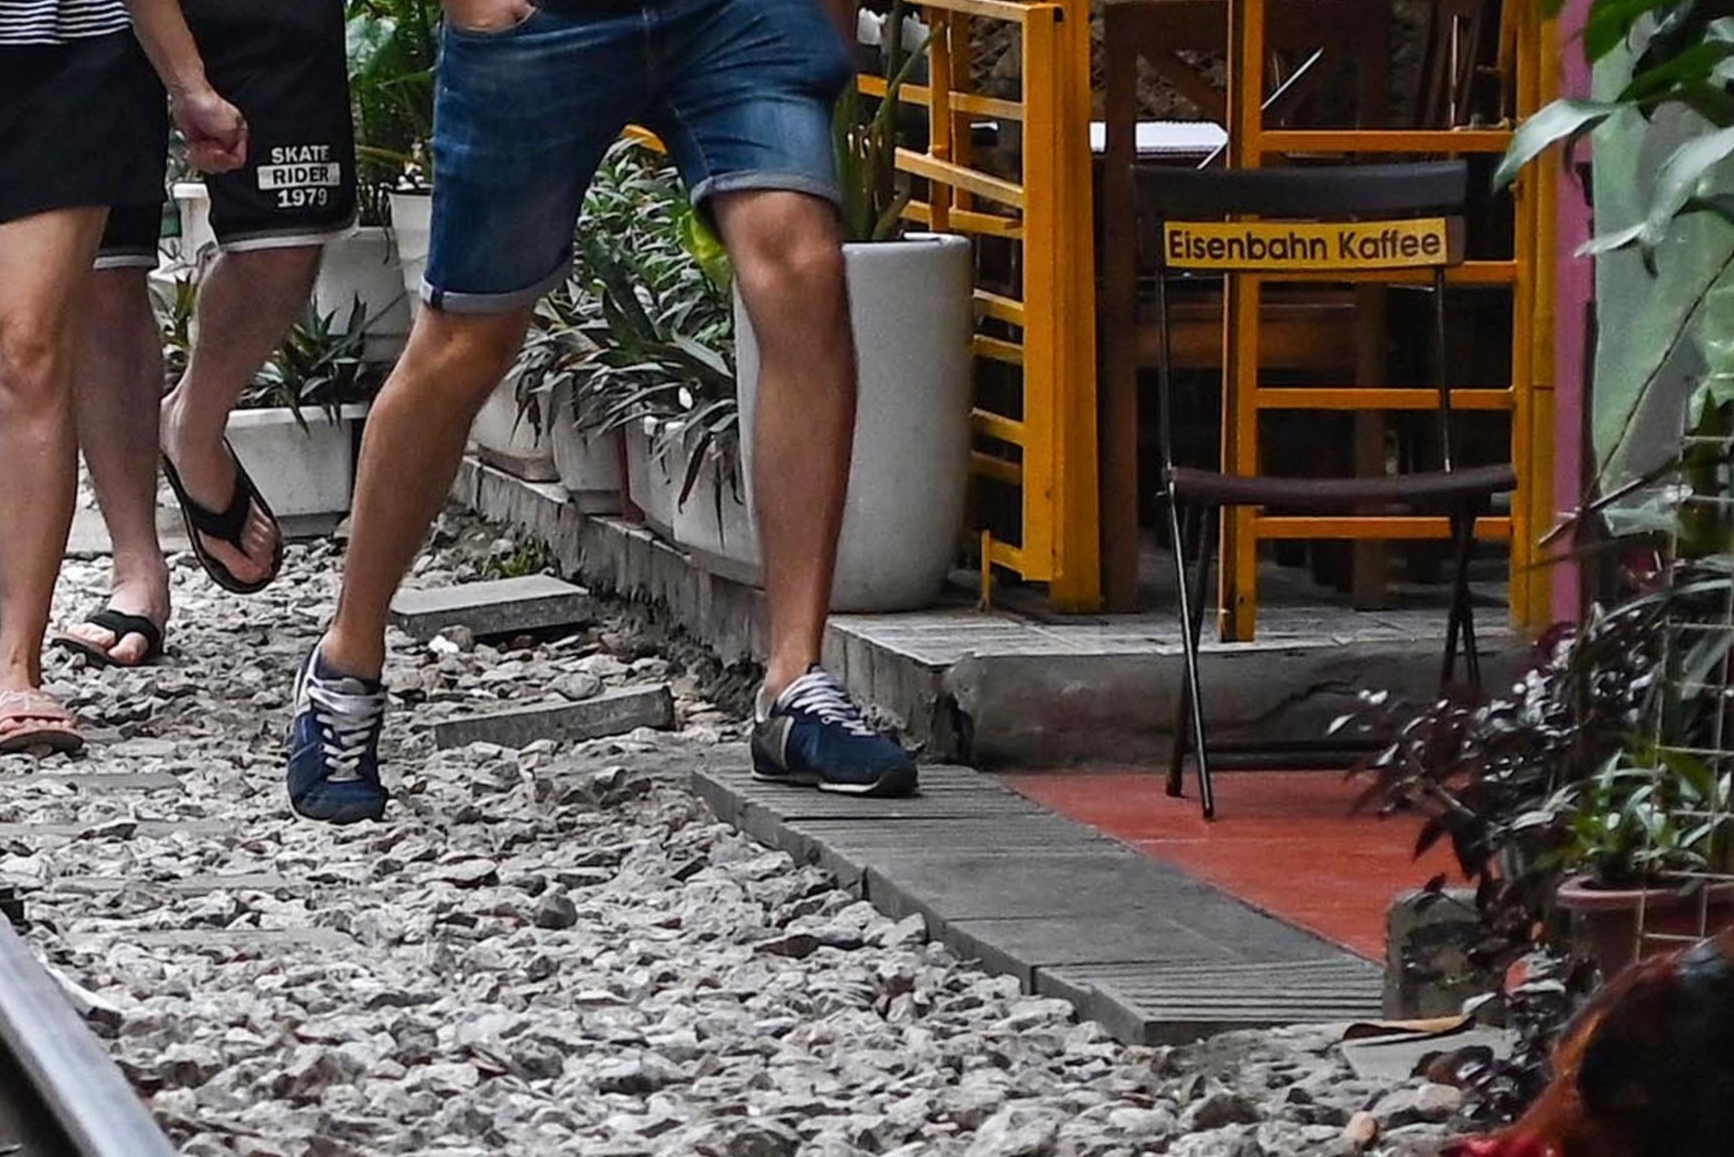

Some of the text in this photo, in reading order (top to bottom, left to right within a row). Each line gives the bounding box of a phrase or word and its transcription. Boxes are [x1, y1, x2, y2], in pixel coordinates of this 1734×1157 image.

[271, 145, 329, 163] SKATE
[273, 166, 328, 184] RIDER
[278, 188, 327, 208] 1979
[1168, 229, 1441, 260] Eisenbahn Kaffee
